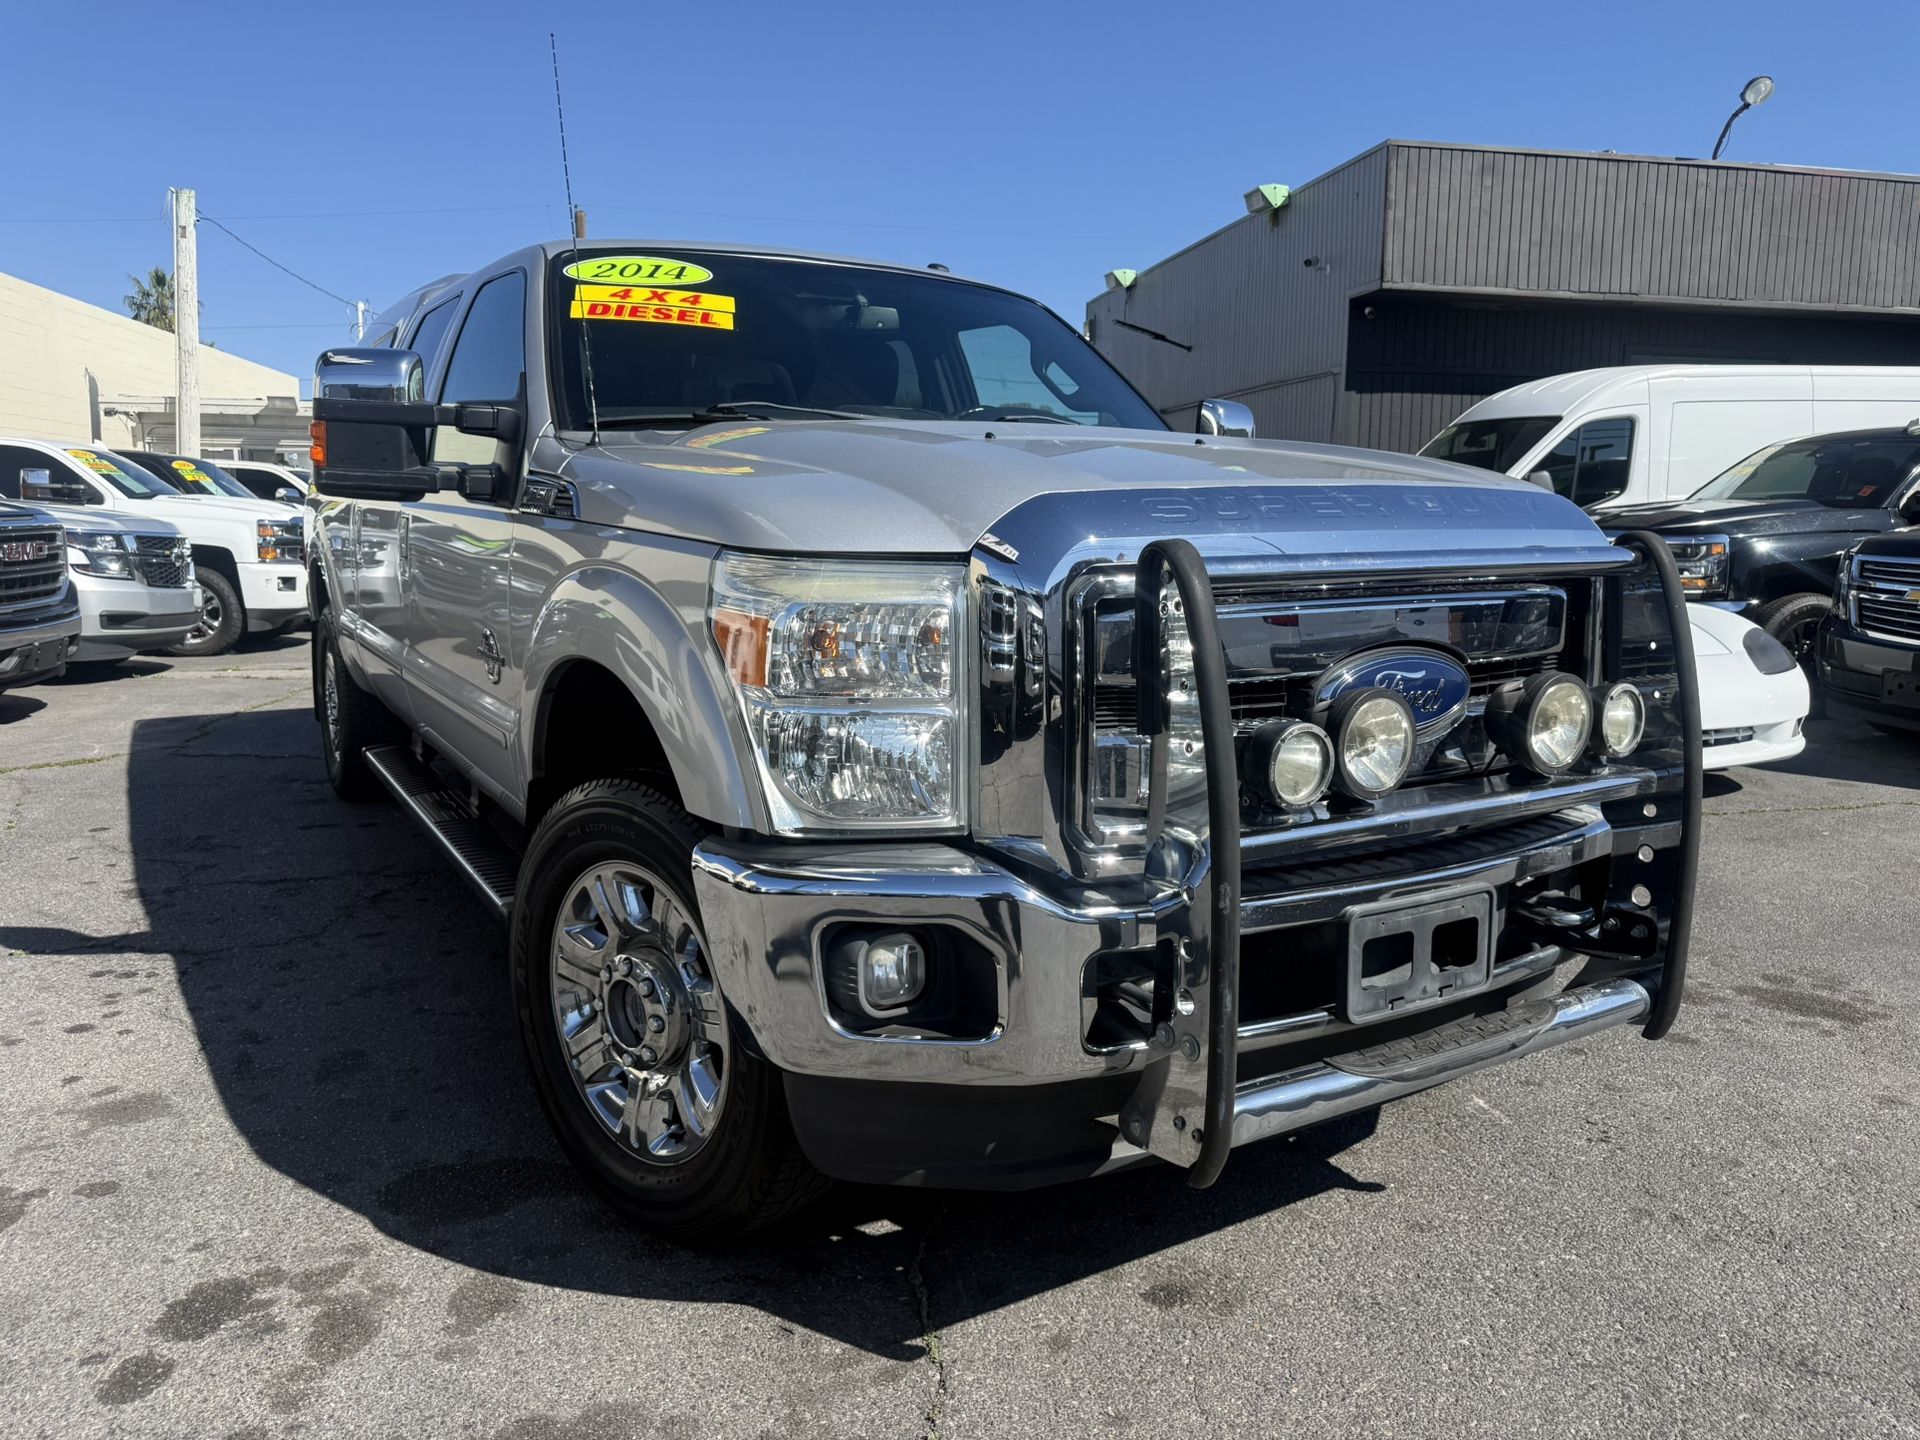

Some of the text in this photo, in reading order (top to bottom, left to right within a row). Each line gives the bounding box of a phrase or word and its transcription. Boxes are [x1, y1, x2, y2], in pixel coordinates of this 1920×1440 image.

[590, 262, 688, 280] 2014
[586, 303, 721, 326] DIESEL
[1141, 494, 1538, 523] SUPER DUTY
